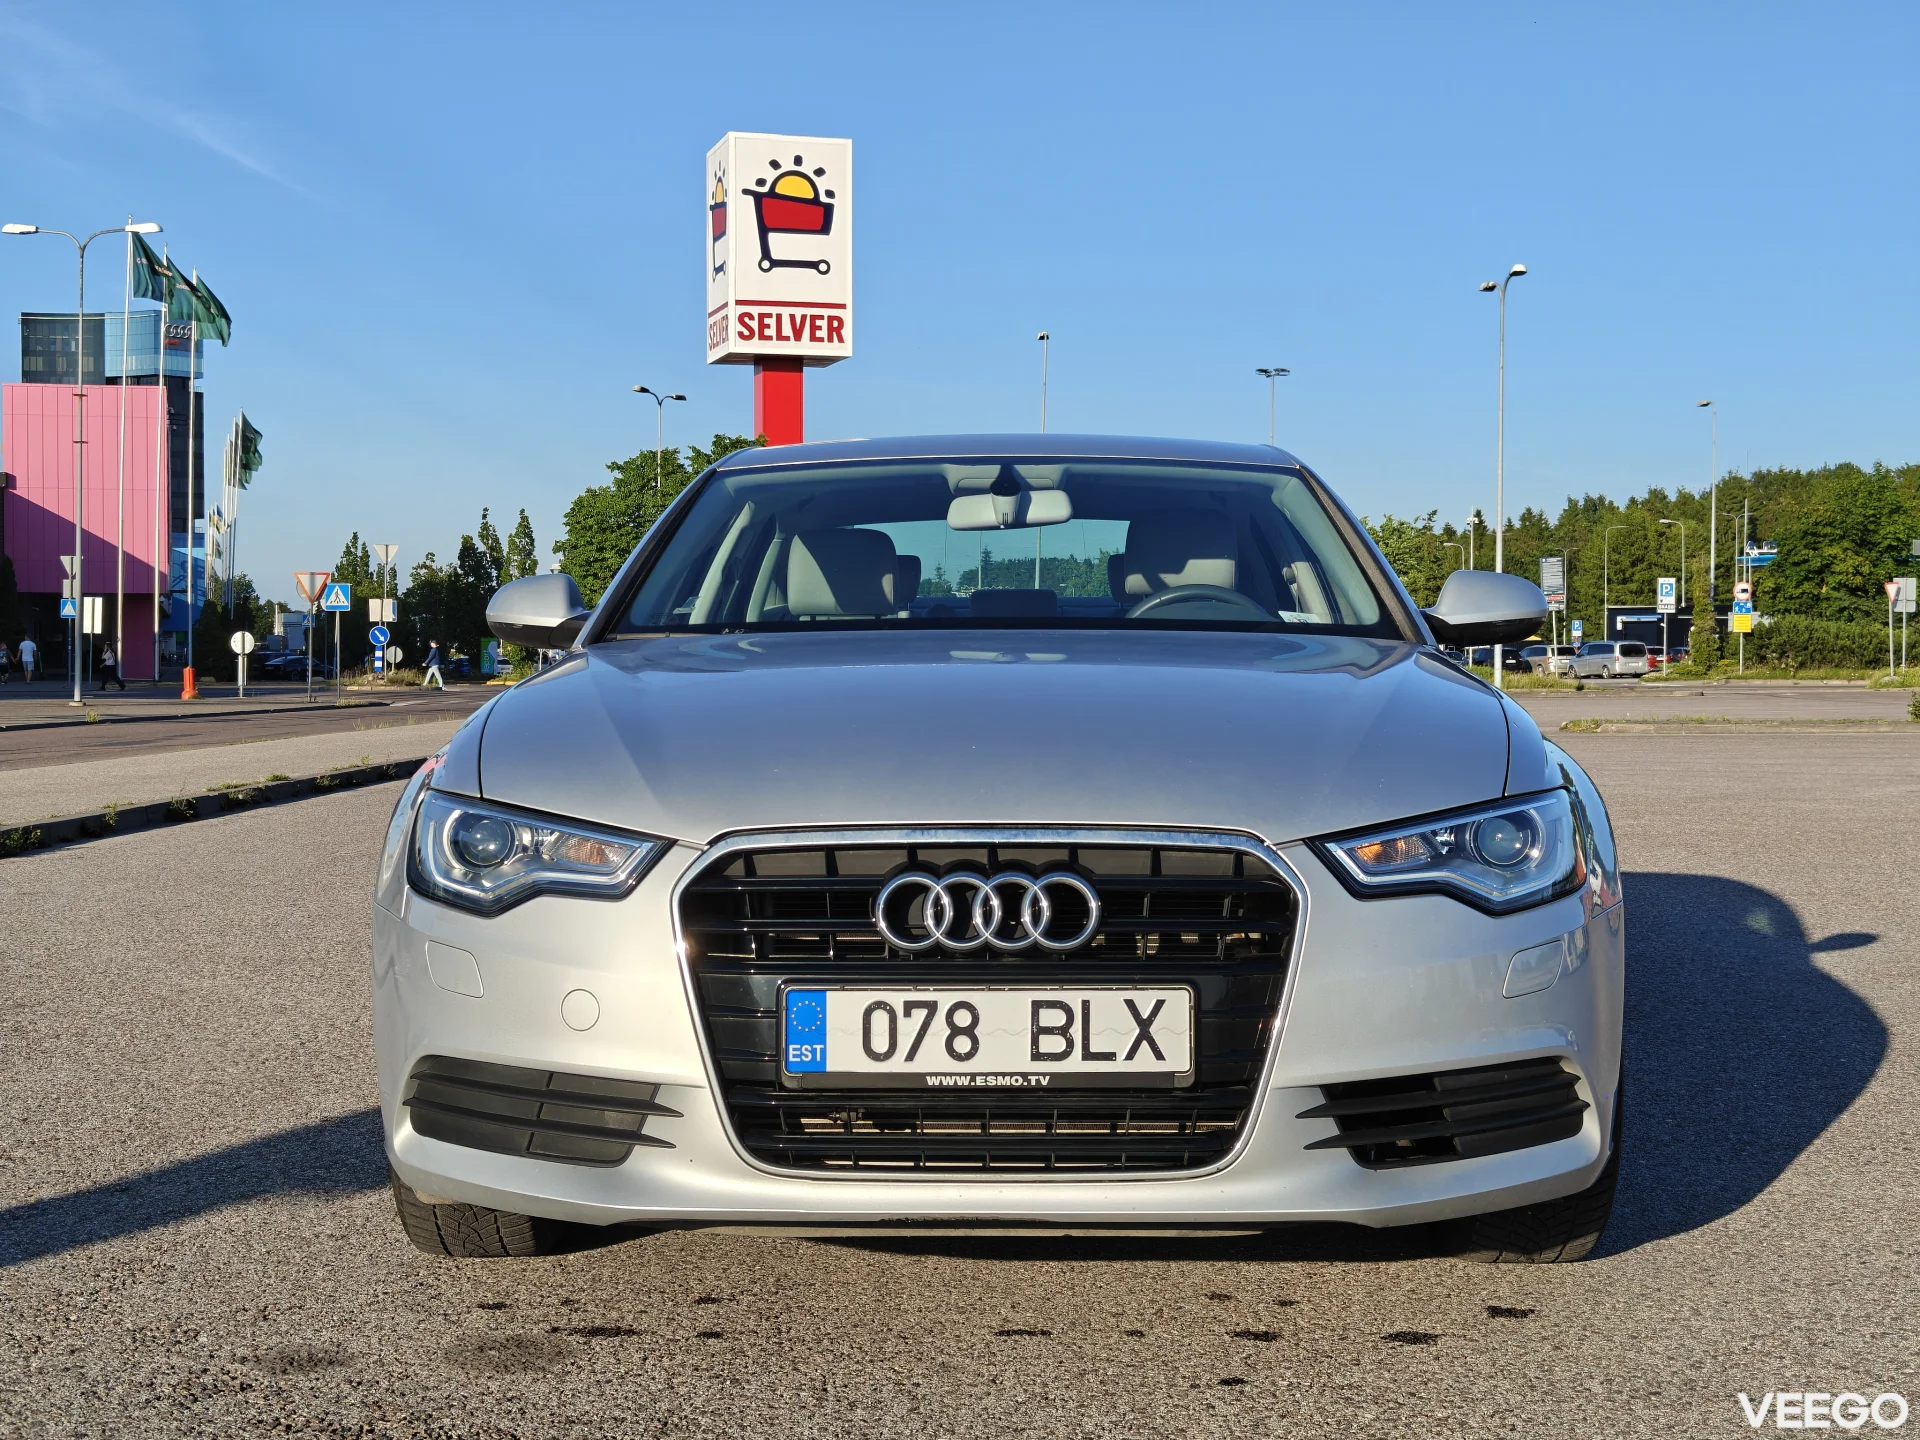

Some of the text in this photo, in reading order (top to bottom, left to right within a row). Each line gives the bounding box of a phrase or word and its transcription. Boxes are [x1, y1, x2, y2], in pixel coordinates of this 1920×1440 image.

[708, 313, 729, 352] SELVER
[737, 312, 845, 344] SELVER
[862, 999, 1167, 1063] 078 BLX
[788, 1044, 825, 1062] EST
[925, 1075, 1051, 1086] WWW.ESMO.TV
